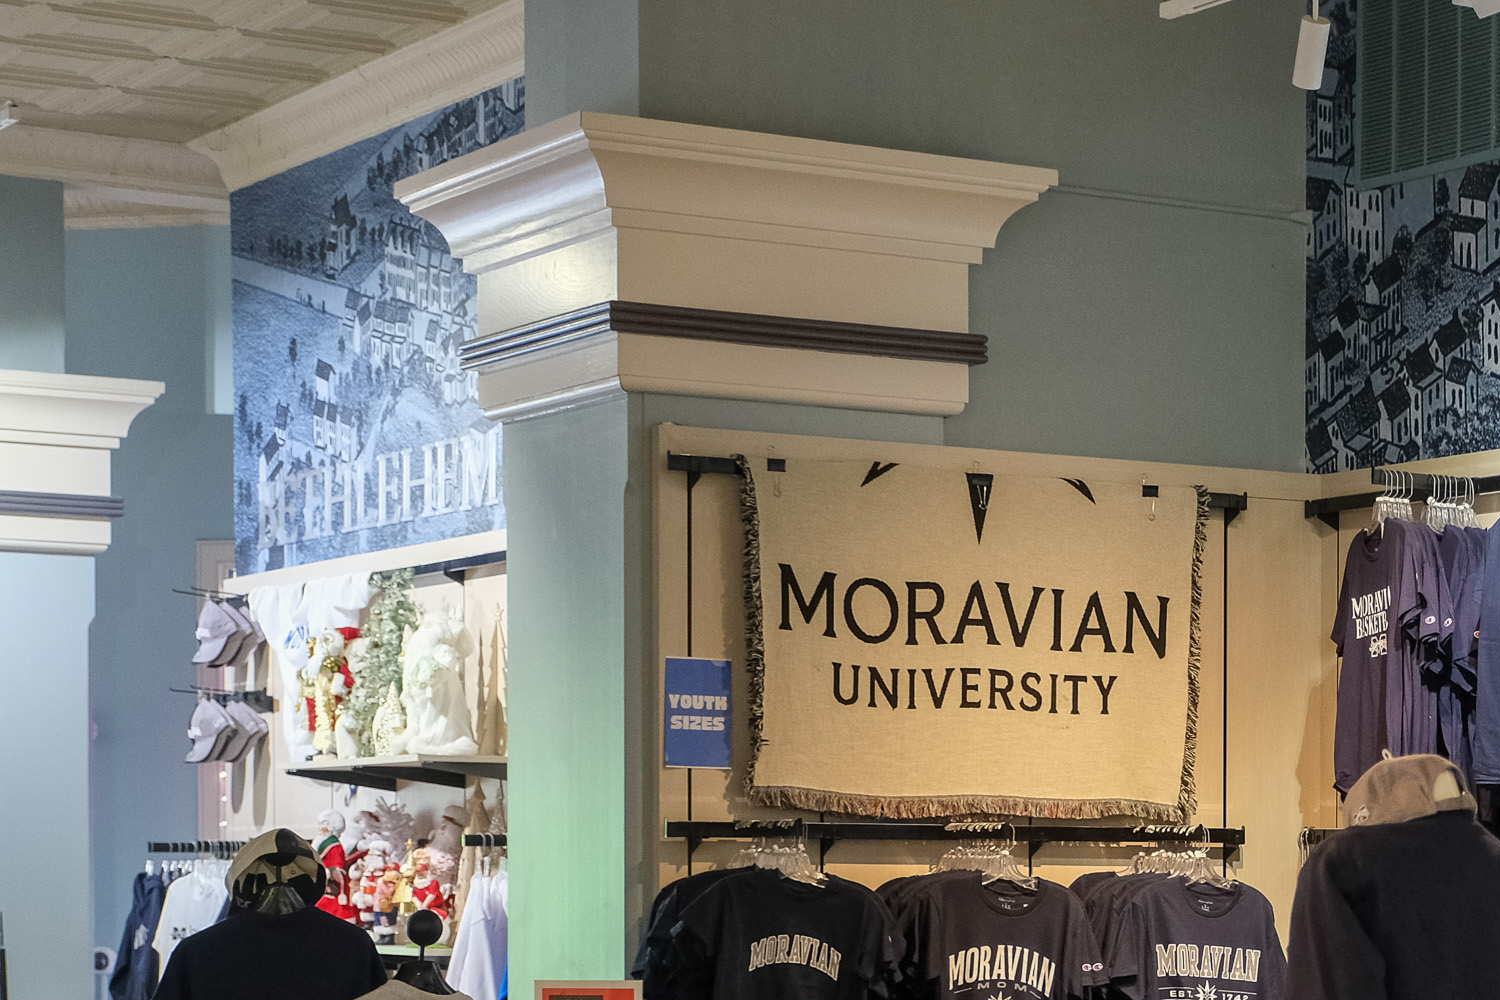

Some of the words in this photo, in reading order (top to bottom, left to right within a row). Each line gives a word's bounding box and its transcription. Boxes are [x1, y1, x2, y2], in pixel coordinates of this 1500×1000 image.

[256, 432, 501, 550] BETHLEHEM
[778, 562, 1170, 659] MORAVIAN
[668, 693, 728, 711] YOUTH
[831, 662, 1118, 715] UNIVERSITY
[670, 715, 726, 731] SIZES
[748, 934, 842, 982] MORAVIAN
[948, 944, 1056, 998] MORAVIAN
[1156, 943, 1261, 983] MORAVIAN
[977, 982, 1028, 992] MOM
[1169, 990, 1194, 1000] EST.
